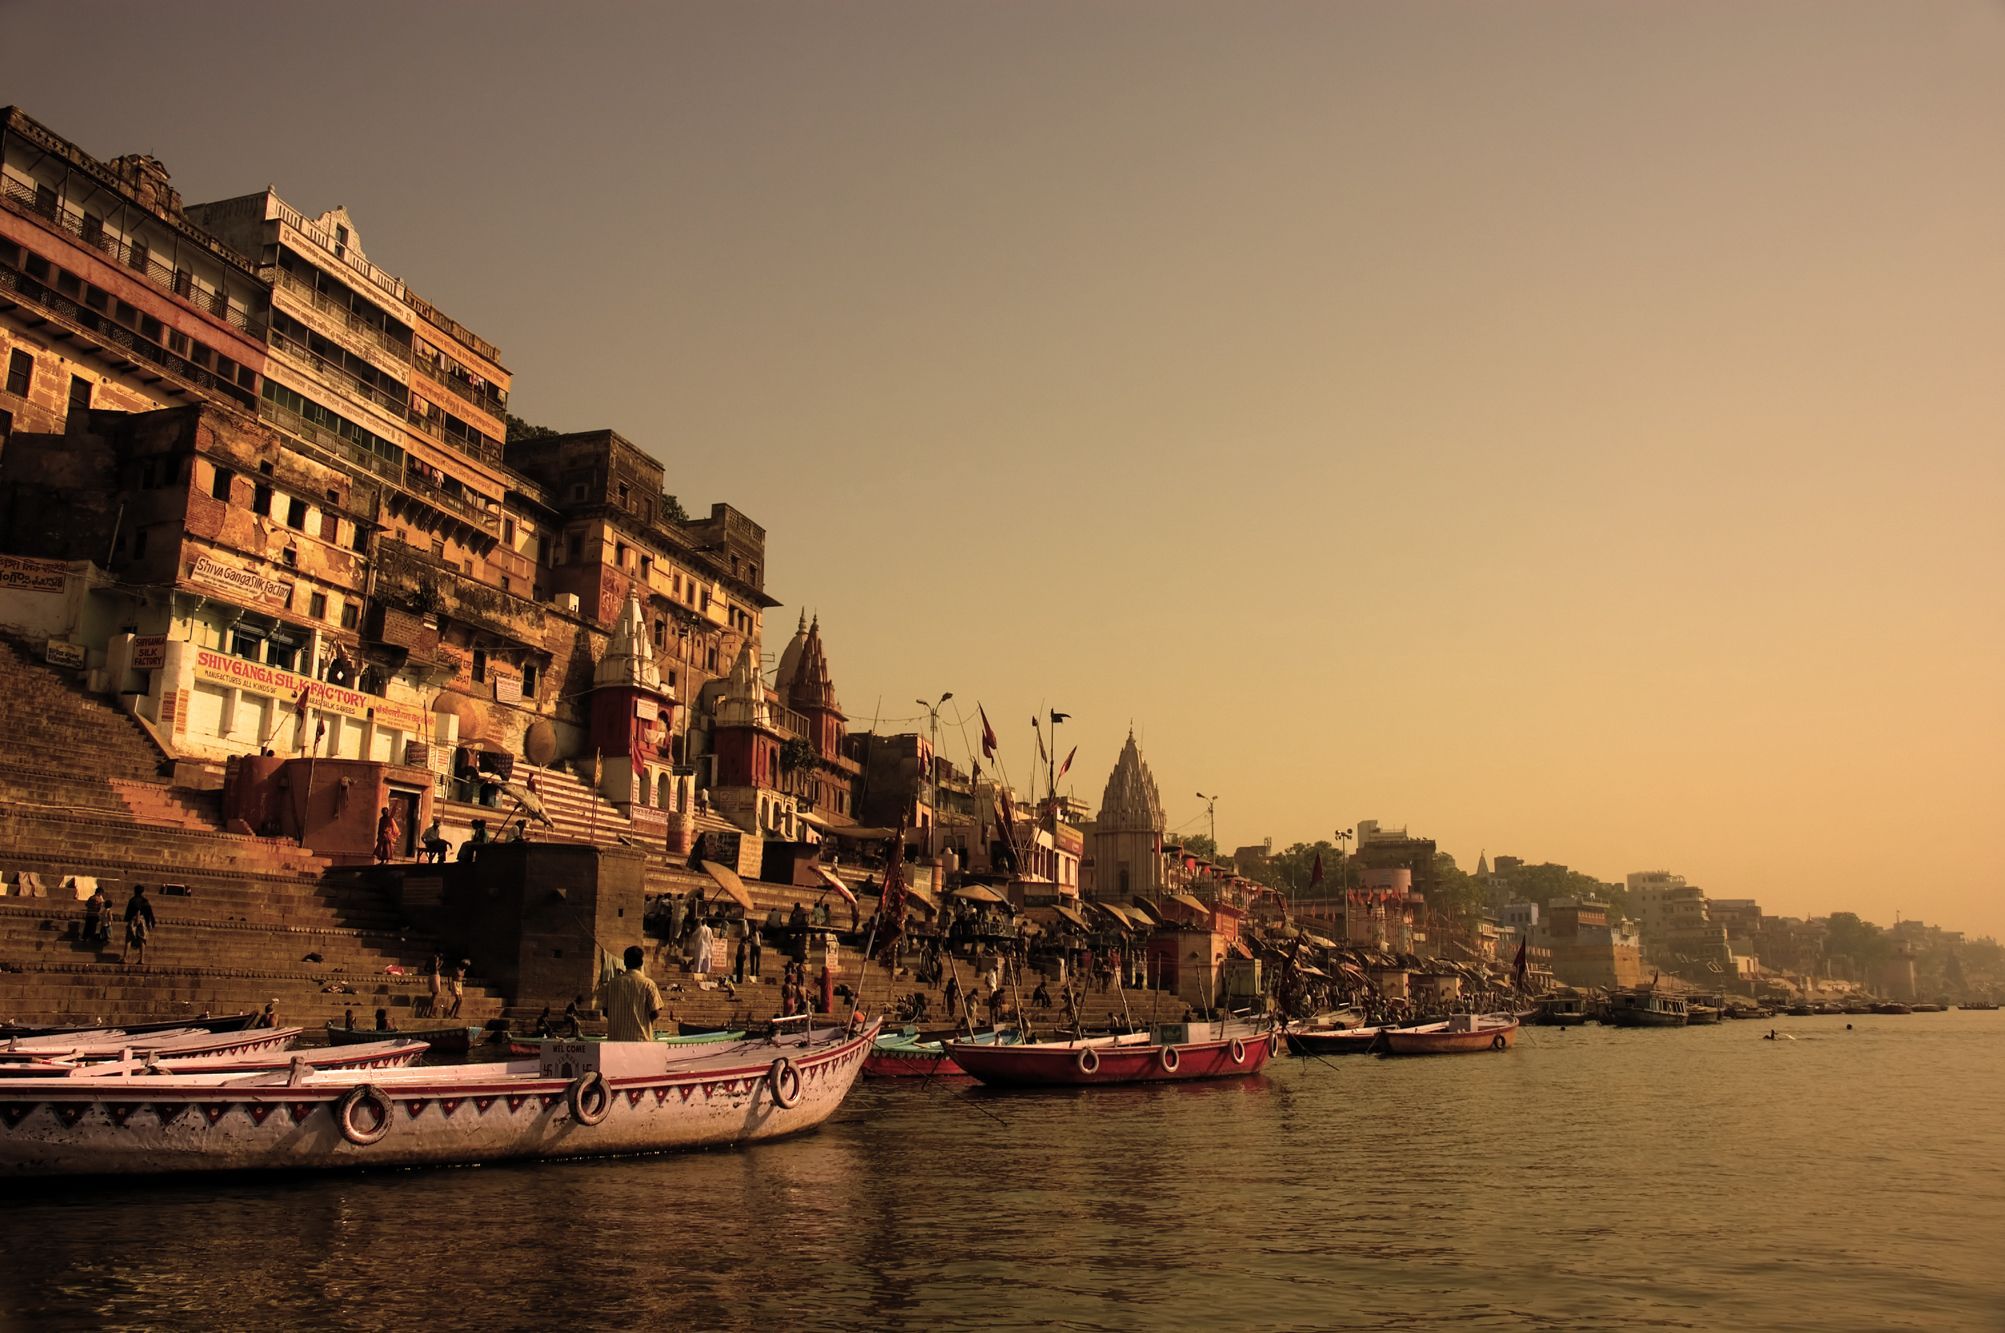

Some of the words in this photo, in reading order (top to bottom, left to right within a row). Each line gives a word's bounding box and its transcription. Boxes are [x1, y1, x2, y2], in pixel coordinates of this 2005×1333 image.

[224, 567, 250, 585] Ganga
[139, 648, 158, 656] SILK
[134, 657, 162, 665] FACTORY
[198, 652, 273, 684] SHIVGANGA
[275, 673, 309, 691] SILK
[310, 682, 367, 708] FACTORY
[205, 670, 241, 685] MANUFACTURES
[242, 680, 252, 689] ALL
[252, 683, 270, 693] KINDS
[322, 700, 335, 710] SILK
[335, 704, 356, 714] SAREES
